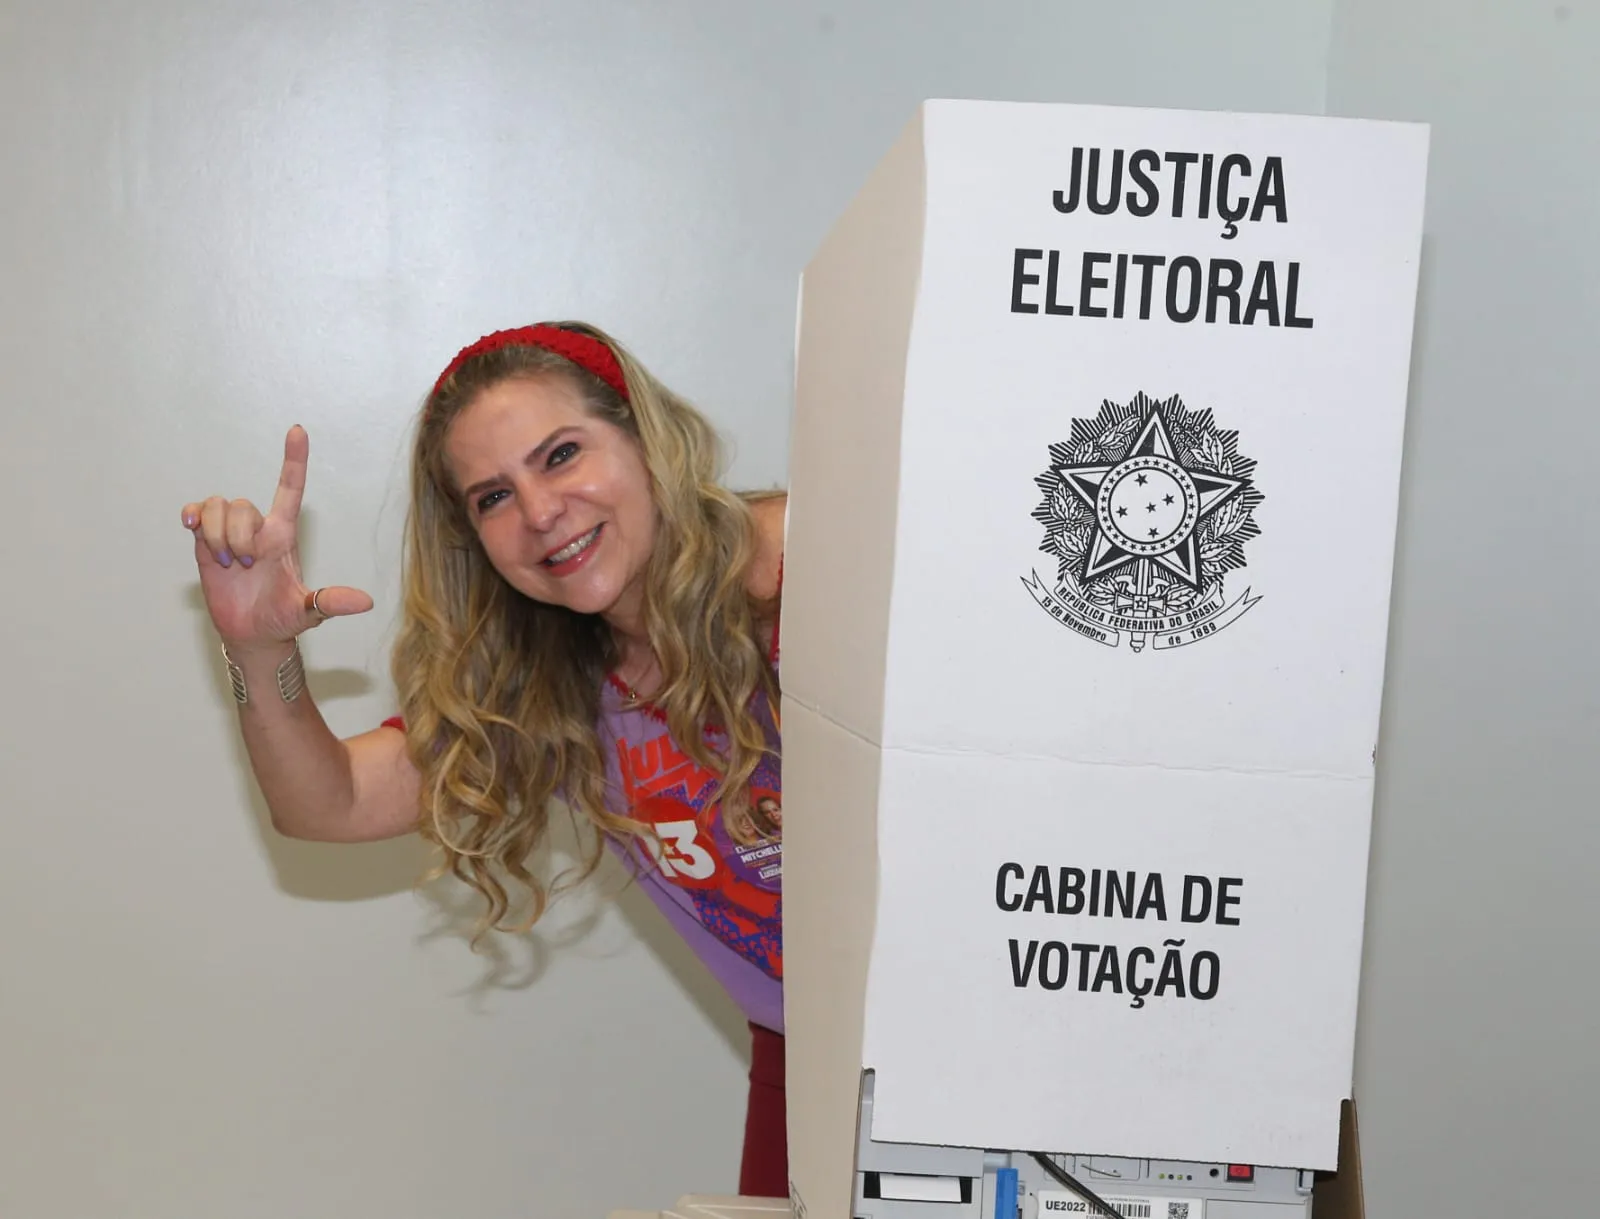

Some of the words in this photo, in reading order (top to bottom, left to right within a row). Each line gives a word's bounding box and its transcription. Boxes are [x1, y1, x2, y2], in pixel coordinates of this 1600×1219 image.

[1053, 147, 1288, 240] JUSTIÇA
[1010, 248, 1314, 329] ELEITORAL
[1041, 596, 1053, 608] 15
[1050, 605, 1063, 617] de
[1062, 613, 1106, 641] Novembro
[1108, 614, 1165, 630] FEDERATIVA
[1169, 616, 1182, 627] DO
[1186, 600, 1219, 622] BRASIL
[1168, 636, 1181, 646] de
[1190, 622, 1217, 639] 1889
[996, 862, 1168, 921] CABINA
[1180, 874, 1243, 926] DE
[1008, 938, 1220, 1009] VOTAÇÃO
[1045, 1200, 1086, 1213] UE2022
